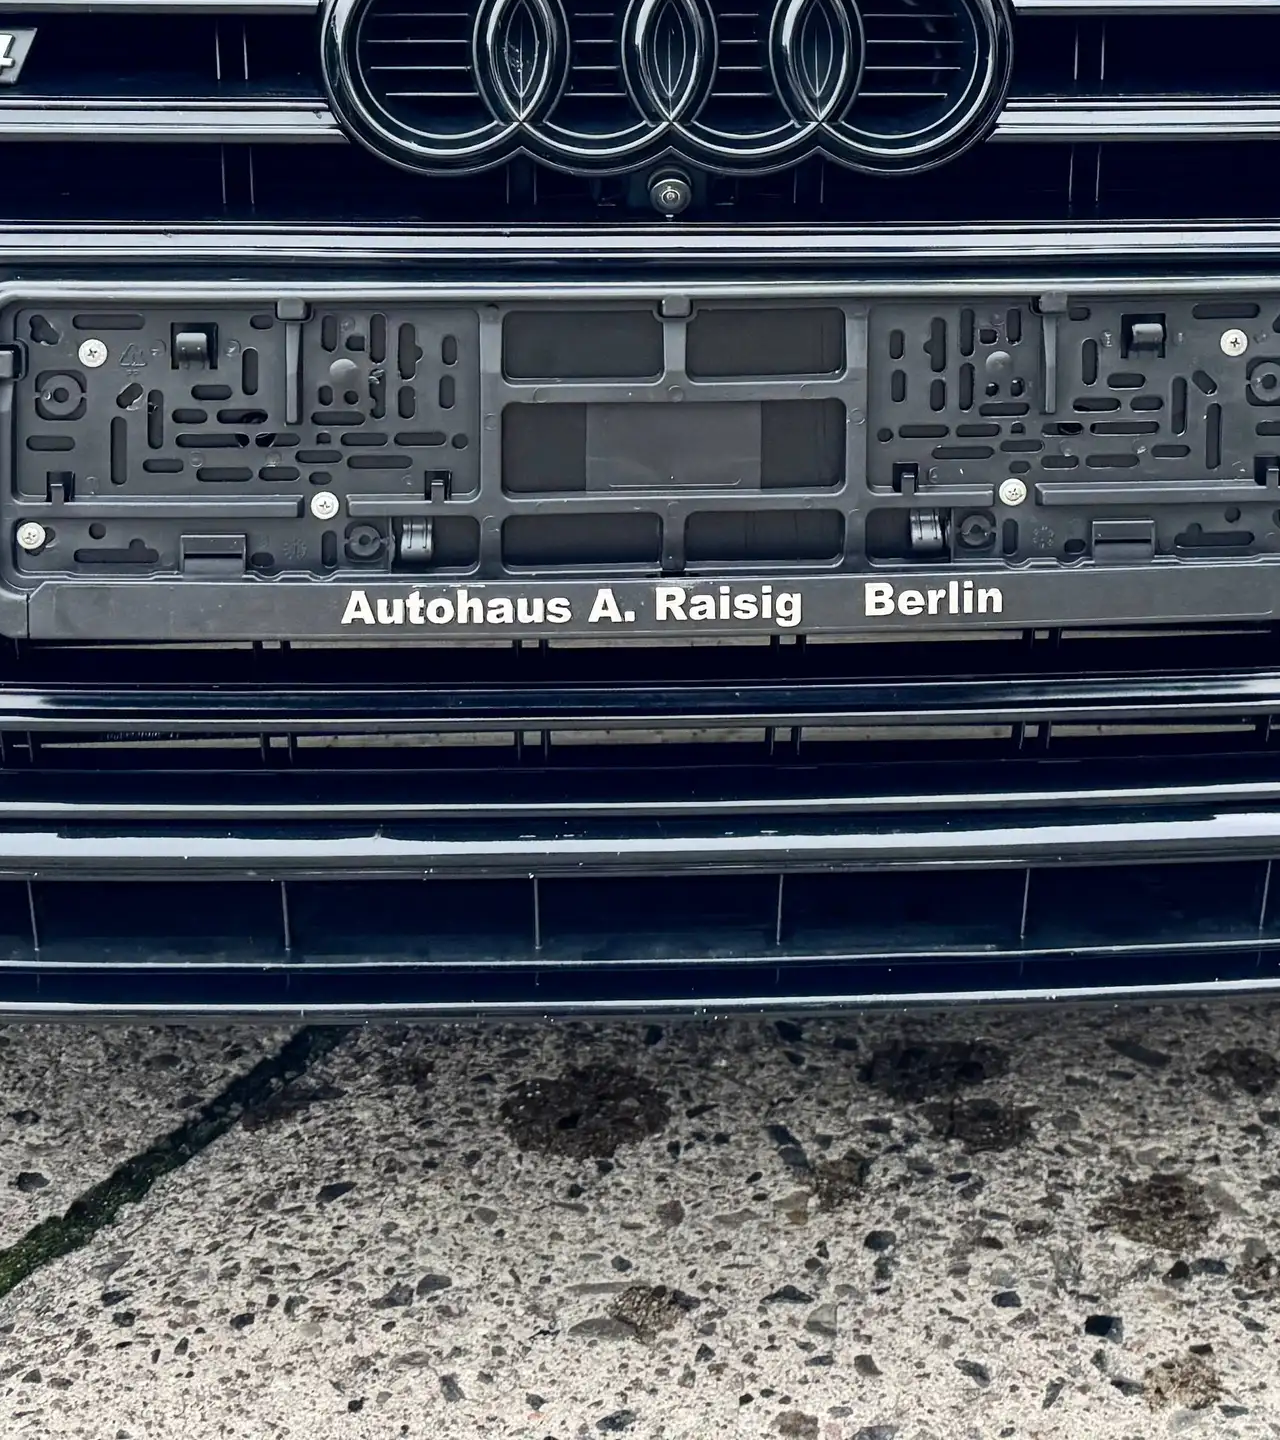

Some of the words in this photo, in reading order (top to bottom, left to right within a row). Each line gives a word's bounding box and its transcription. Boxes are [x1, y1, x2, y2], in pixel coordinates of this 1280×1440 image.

[340, 589, 572, 625] Autohaus
[588, 588, 635, 623] A.
[655, 585, 802, 627] Raisig
[864, 580, 1003, 617] Berlin
